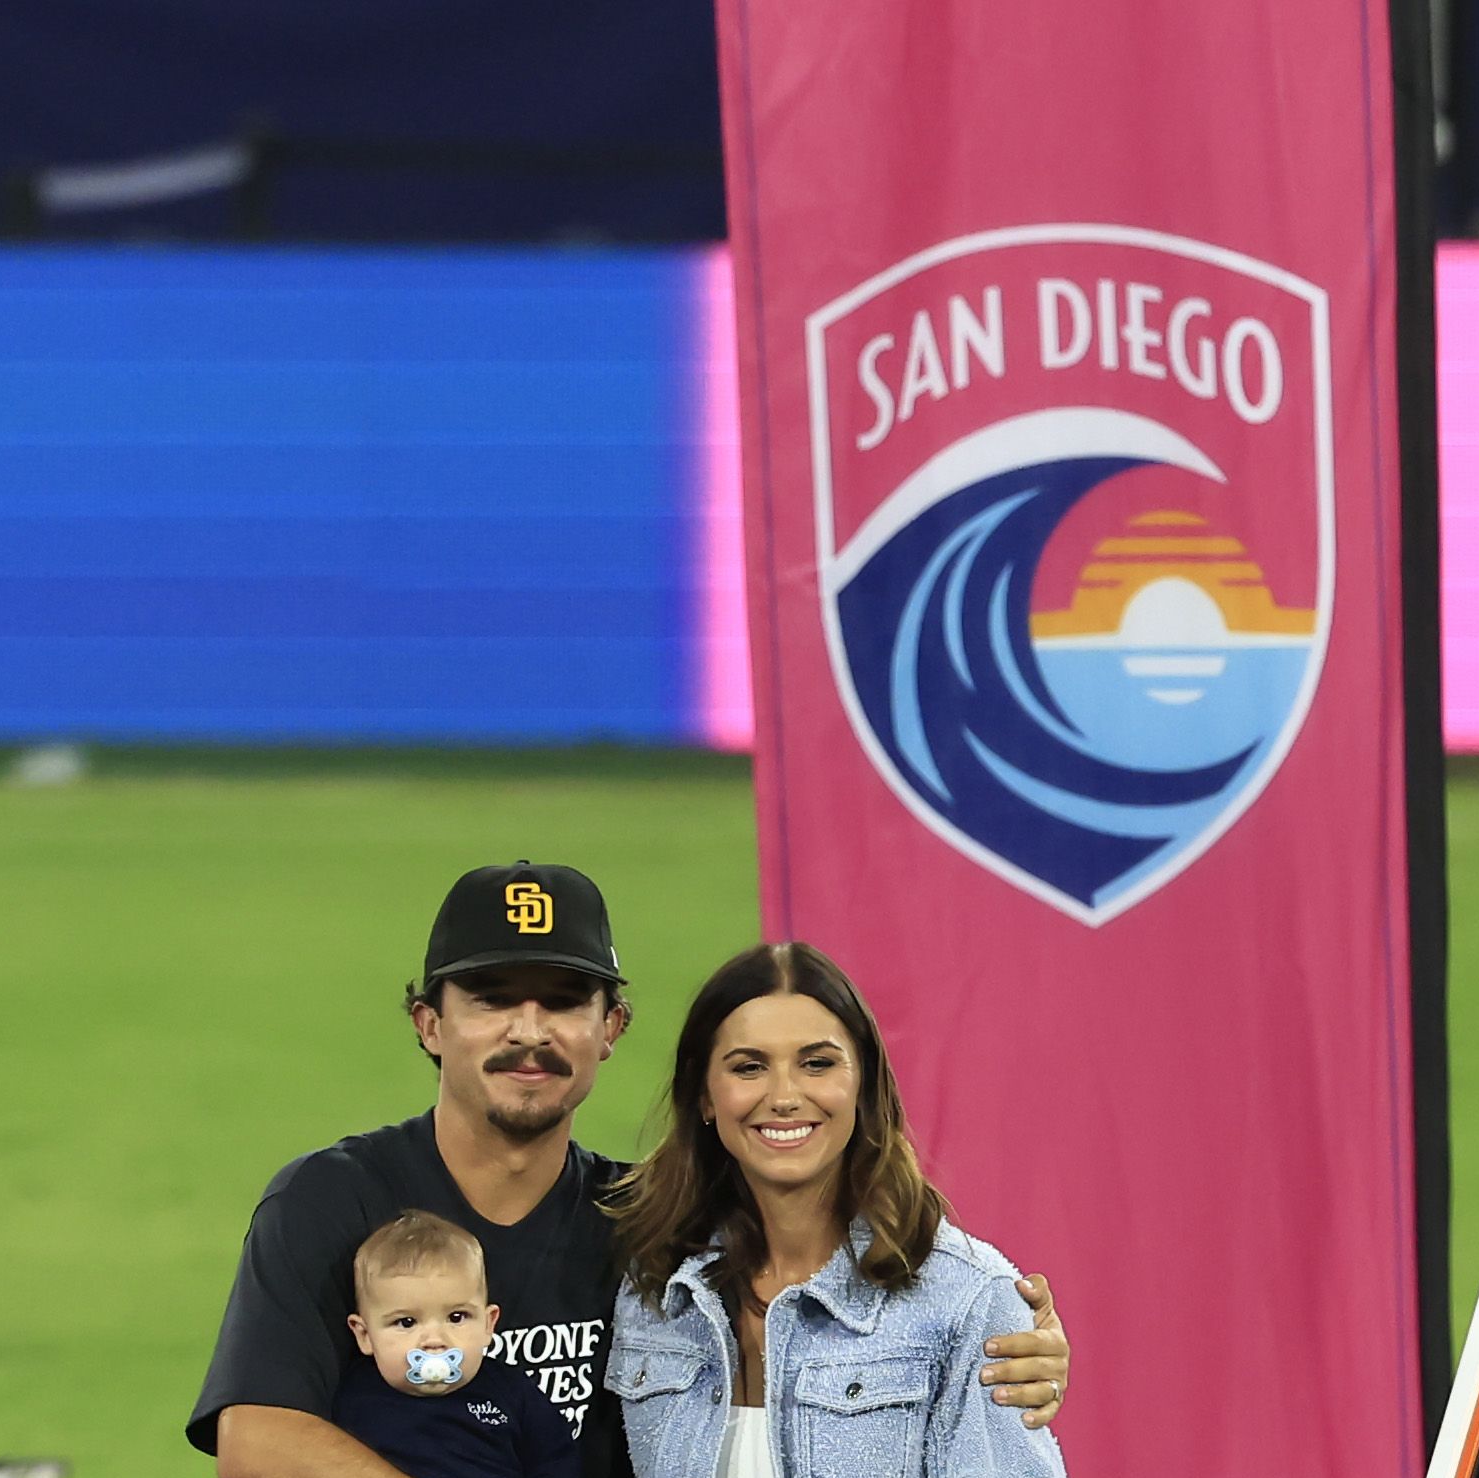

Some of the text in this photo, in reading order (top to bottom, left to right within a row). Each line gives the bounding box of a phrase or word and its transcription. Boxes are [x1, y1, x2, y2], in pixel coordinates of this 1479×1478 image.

[856, 278, 1285, 451] SAN DIEGO
[505, 881, 553, 934] SD
